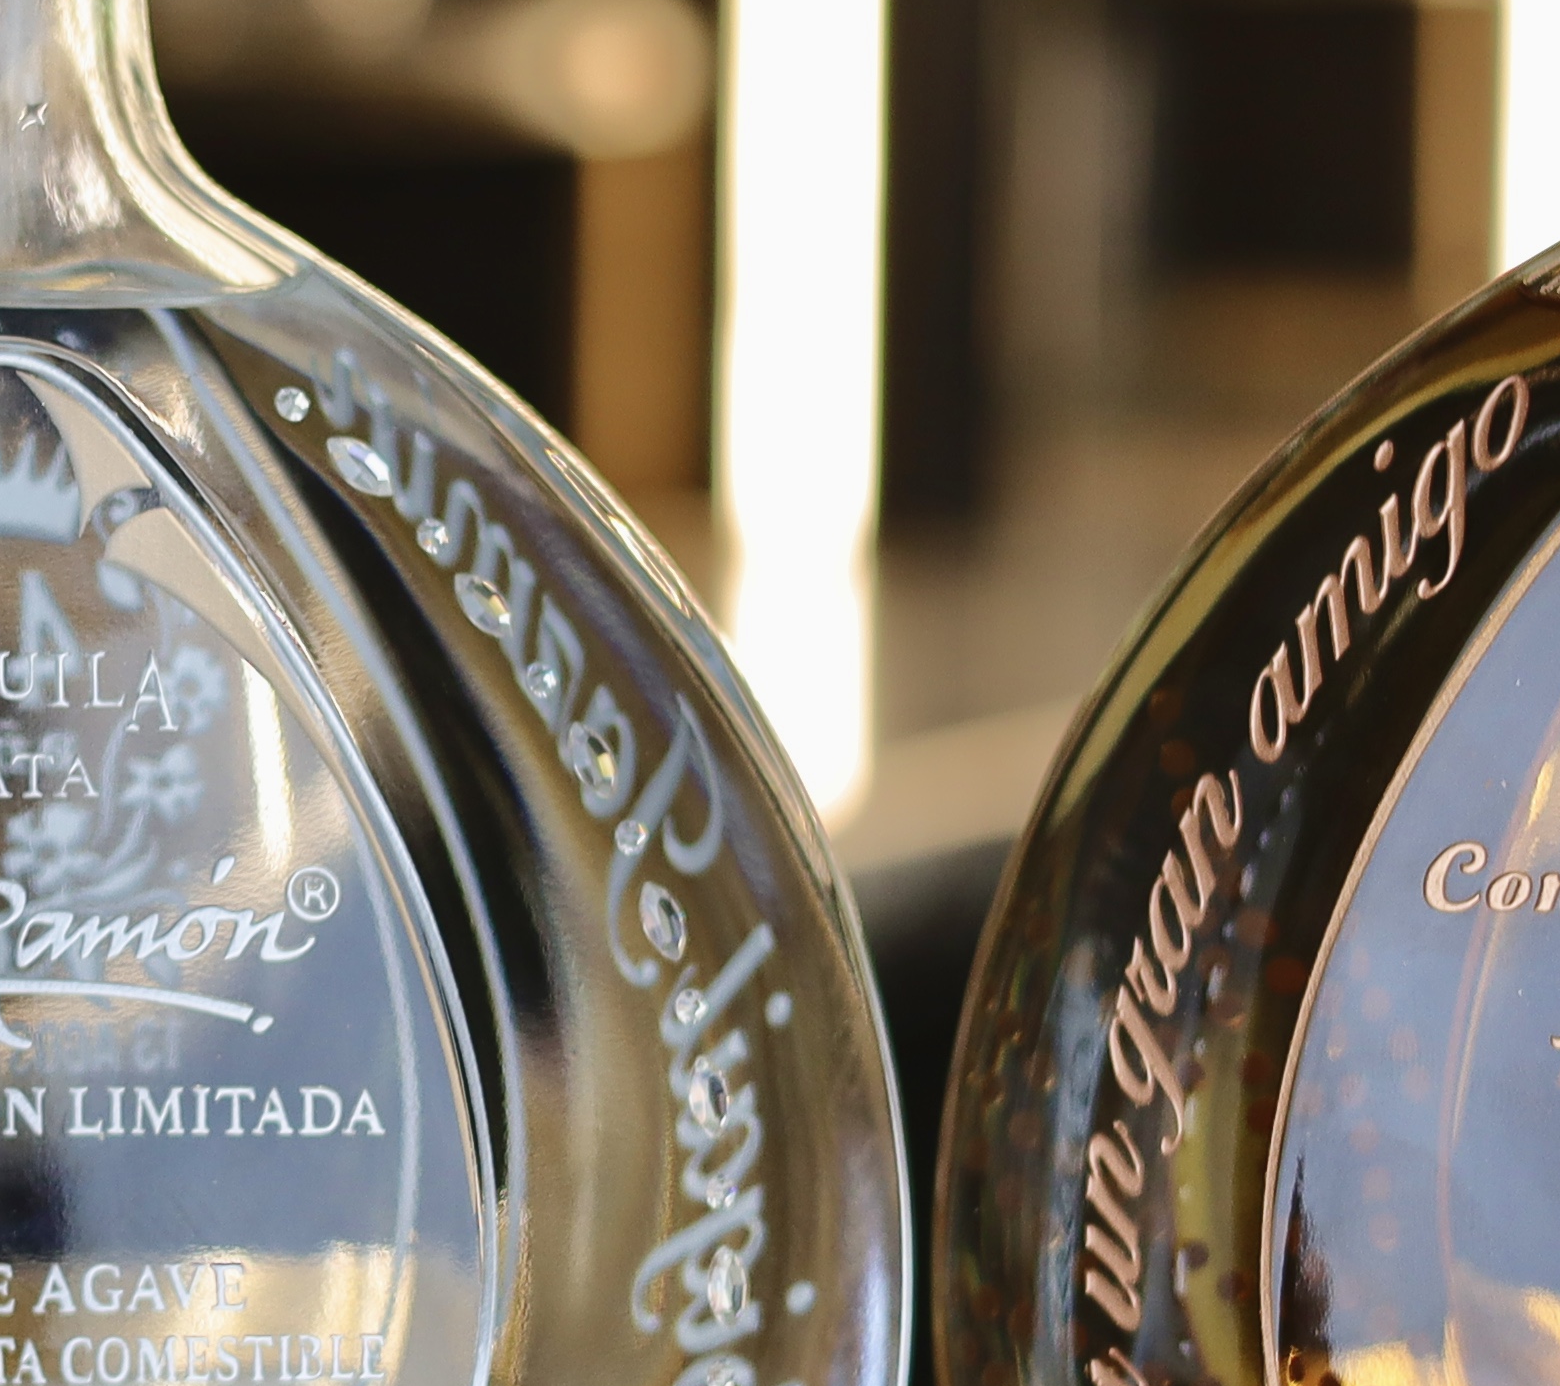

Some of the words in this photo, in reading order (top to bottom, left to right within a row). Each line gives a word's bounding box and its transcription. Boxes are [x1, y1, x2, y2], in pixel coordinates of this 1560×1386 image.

[1247, 371, 1531, 764] amigo
[1106, 766, 1248, 1157] gran
[69, 1085, 386, 1138] LIMITADA
[32, 1263, 248, 1316] AGAVE
[1079, 1116, 1145, 1331] un
[63, 1333, 388, 1385] COMESTIBLE
